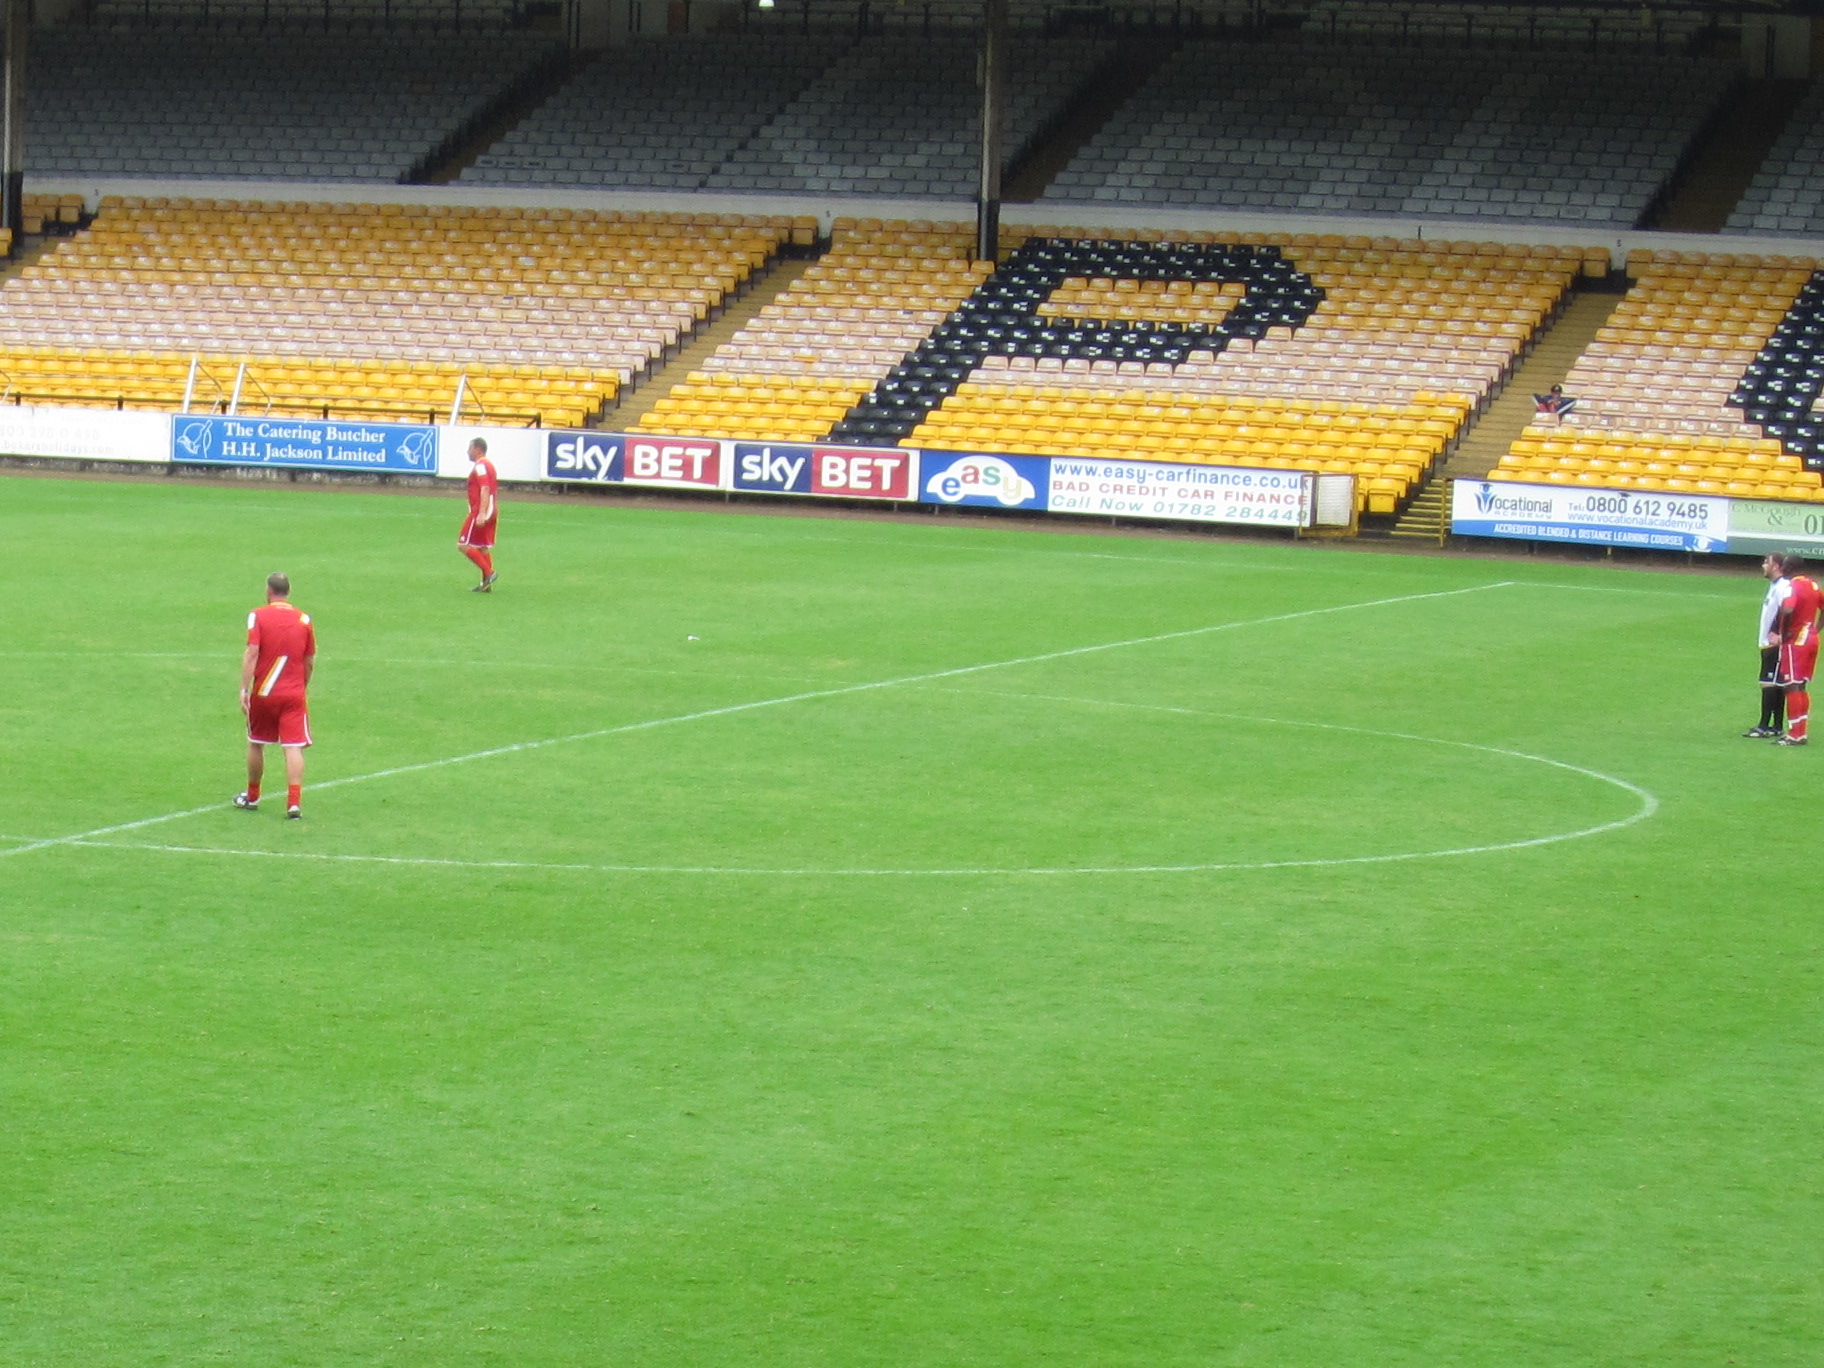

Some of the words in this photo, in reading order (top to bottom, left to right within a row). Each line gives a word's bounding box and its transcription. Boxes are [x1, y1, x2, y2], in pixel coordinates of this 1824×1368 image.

[223, 422, 254, 437] The
[257, 423, 322, 444] Catering
[326, 426, 386, 443] Butcher
[221, 441, 261, 457] H.H.
[264, 442, 323, 461] Jackson
[327, 445, 386, 462] Limited
[555, 436, 618, 480] sky
[633, 444, 712, 479] BET
[742, 447, 806, 490] sky
[821, 456, 901, 490] BET
[941, 464, 1022, 499] easy
[1054, 463, 1308, 491] www.easy-carfinance.co.uk
[1051, 494, 1090, 509] Call
[1099, 497, 1144, 511] Now
[1153, 501, 1216, 516] 01782
[1052, 480, 1090, 492] BAD
[1099, 482, 1169, 497] CREDIT
[1177, 487, 1215, 499] CAR
[1224, 490, 1308, 506] FINANCE
[1586, 496, 1627, 514] 0800
[1633, 499, 1661, 516] 612
[1667, 501, 1708, 519] 9485
